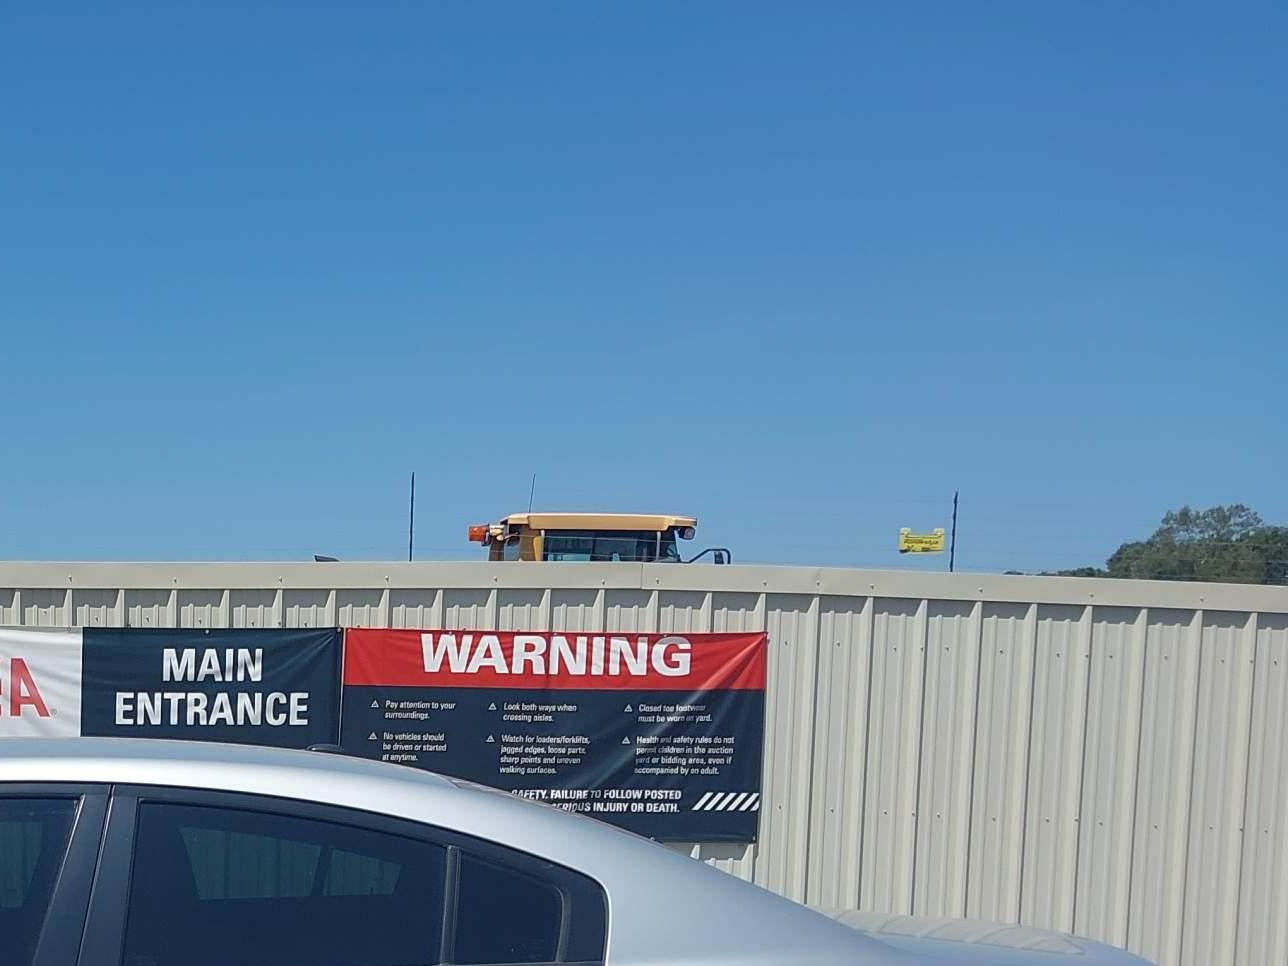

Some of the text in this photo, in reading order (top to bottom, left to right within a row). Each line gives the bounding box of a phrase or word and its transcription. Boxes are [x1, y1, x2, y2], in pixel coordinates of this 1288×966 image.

[420, 634, 692, 677] WARNING
[162, 648, 263, 682] MAIN
[115, 692, 309, 726] ENTRANCE
[385, 700, 399, 710] Pay
[400, 701, 430, 709] attention
[440, 703, 456, 711] your
[504, 703, 577, 713] Look both ways when
[639, 704, 706, 712] Closed toe footwear
[384, 711, 431, 720] surroundings.
[503, 714, 554, 723] crossing aisles.
[695, 714, 713, 724] yard.
[384, 732, 445, 741] No vehicles should
[502, 735, 591, 745] Watch for loaders/forklifts,
[637, 736, 659, 744] Health
[673, 736, 694, 745] safety
[695, 736, 712, 744] rules
[714, 736, 722, 744] do
[382, 742, 392, 751] be
[393, 743, 413, 751] driven
[422, 744, 447, 752] started
[500, 745, 524, 754] jagged
[548, 746, 566, 754] loose
[636, 746, 657, 756] permit
[658, 746, 685, 754] children
[686, 746, 693, 754] in
[694, 746, 706, 754] the
[390, 754, 418, 762] anytime.
[500, 756, 520, 764] sharp
[520, 756, 541, 765] points
[543, 756, 556, 764] and
[661, 756, 687, 766] bidding
[726, 756, 732, 764] if
[500, 766, 557, 775] walking surfaces.
[634, 767, 679, 775] accompanied
[680, 767, 689, 776] by
[550, 790, 588, 800] FAILURE
[590, 790, 602, 799] TO
[604, 790, 643, 800] FOLLOW
[644, 790, 682, 800] POSTED
[593, 803, 627, 812] INJURY
[631, 803, 644, 812] OR
[646, 803, 680, 813] DEATH.
